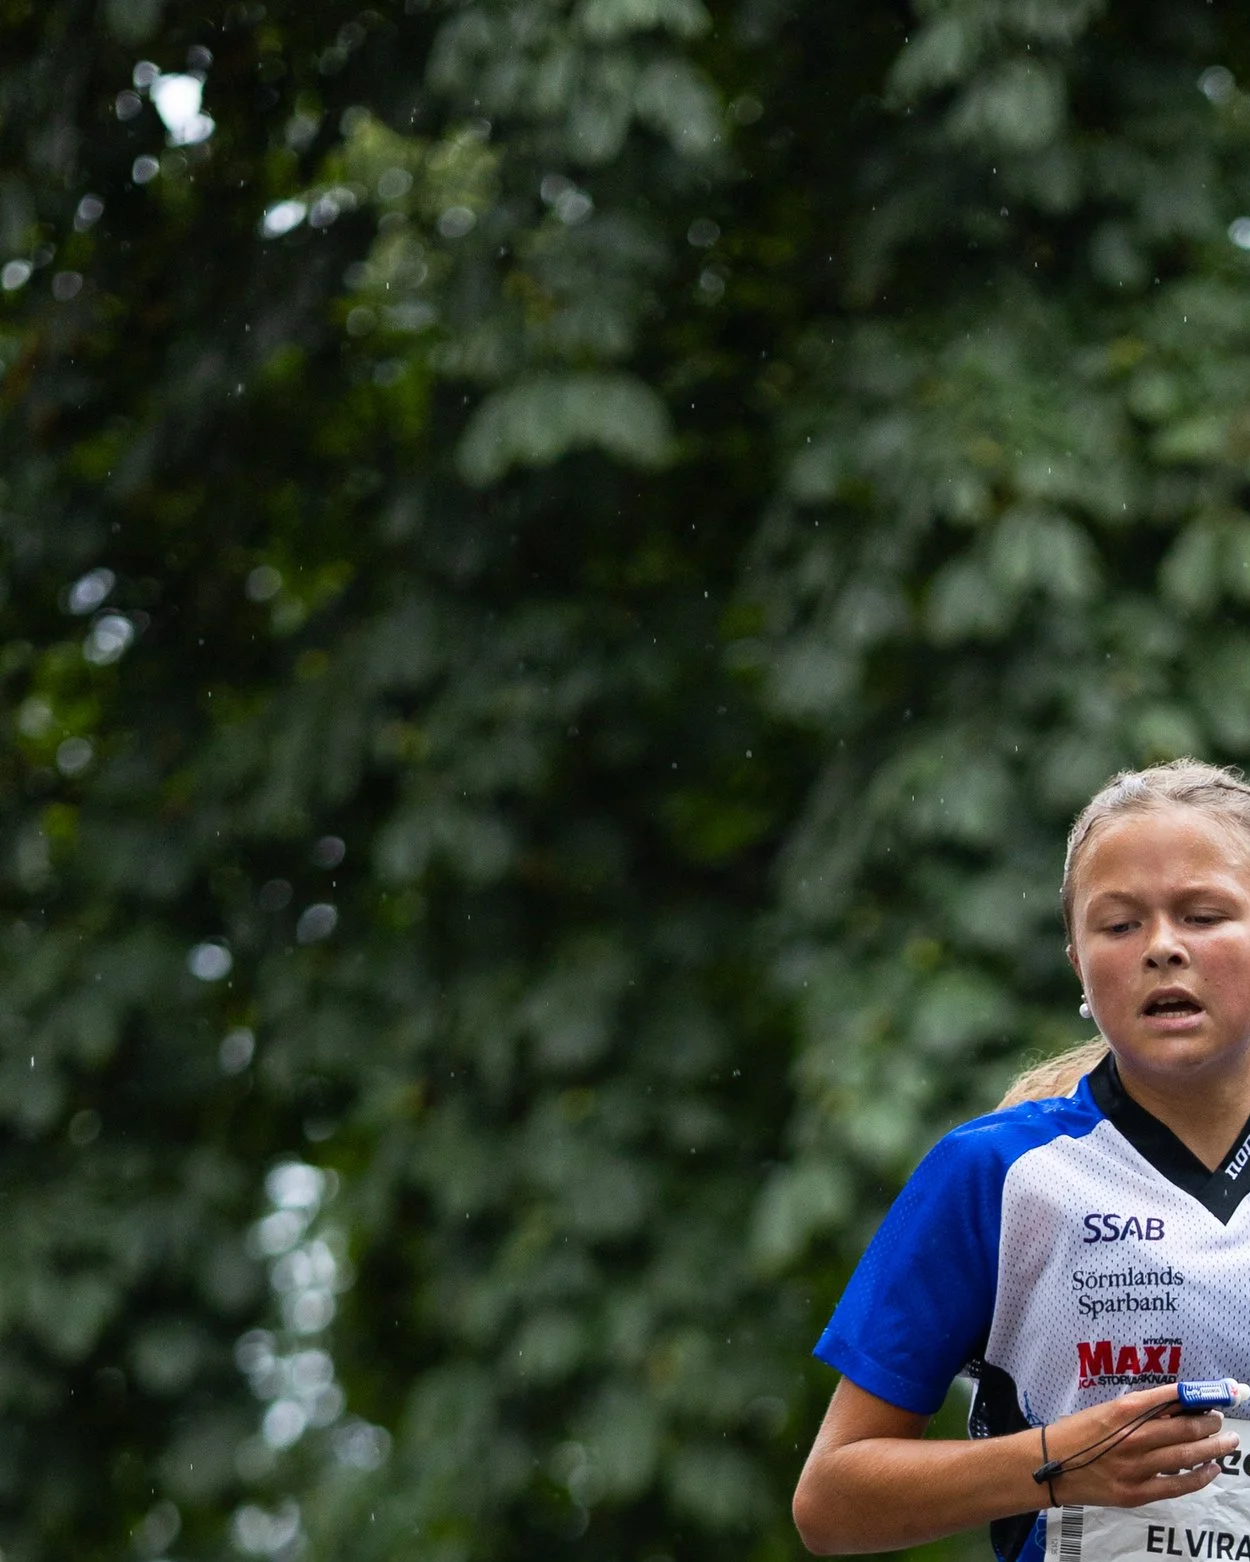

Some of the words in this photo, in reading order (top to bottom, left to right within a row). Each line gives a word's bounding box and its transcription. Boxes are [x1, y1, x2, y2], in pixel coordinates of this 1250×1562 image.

[1083, 1213, 1165, 1243] SSAB
[1072, 1266, 1184, 1291] Sörmlands
[1078, 1292, 1179, 1320] Sparbank
[1077, 1341, 1182, 1378] MAXI
